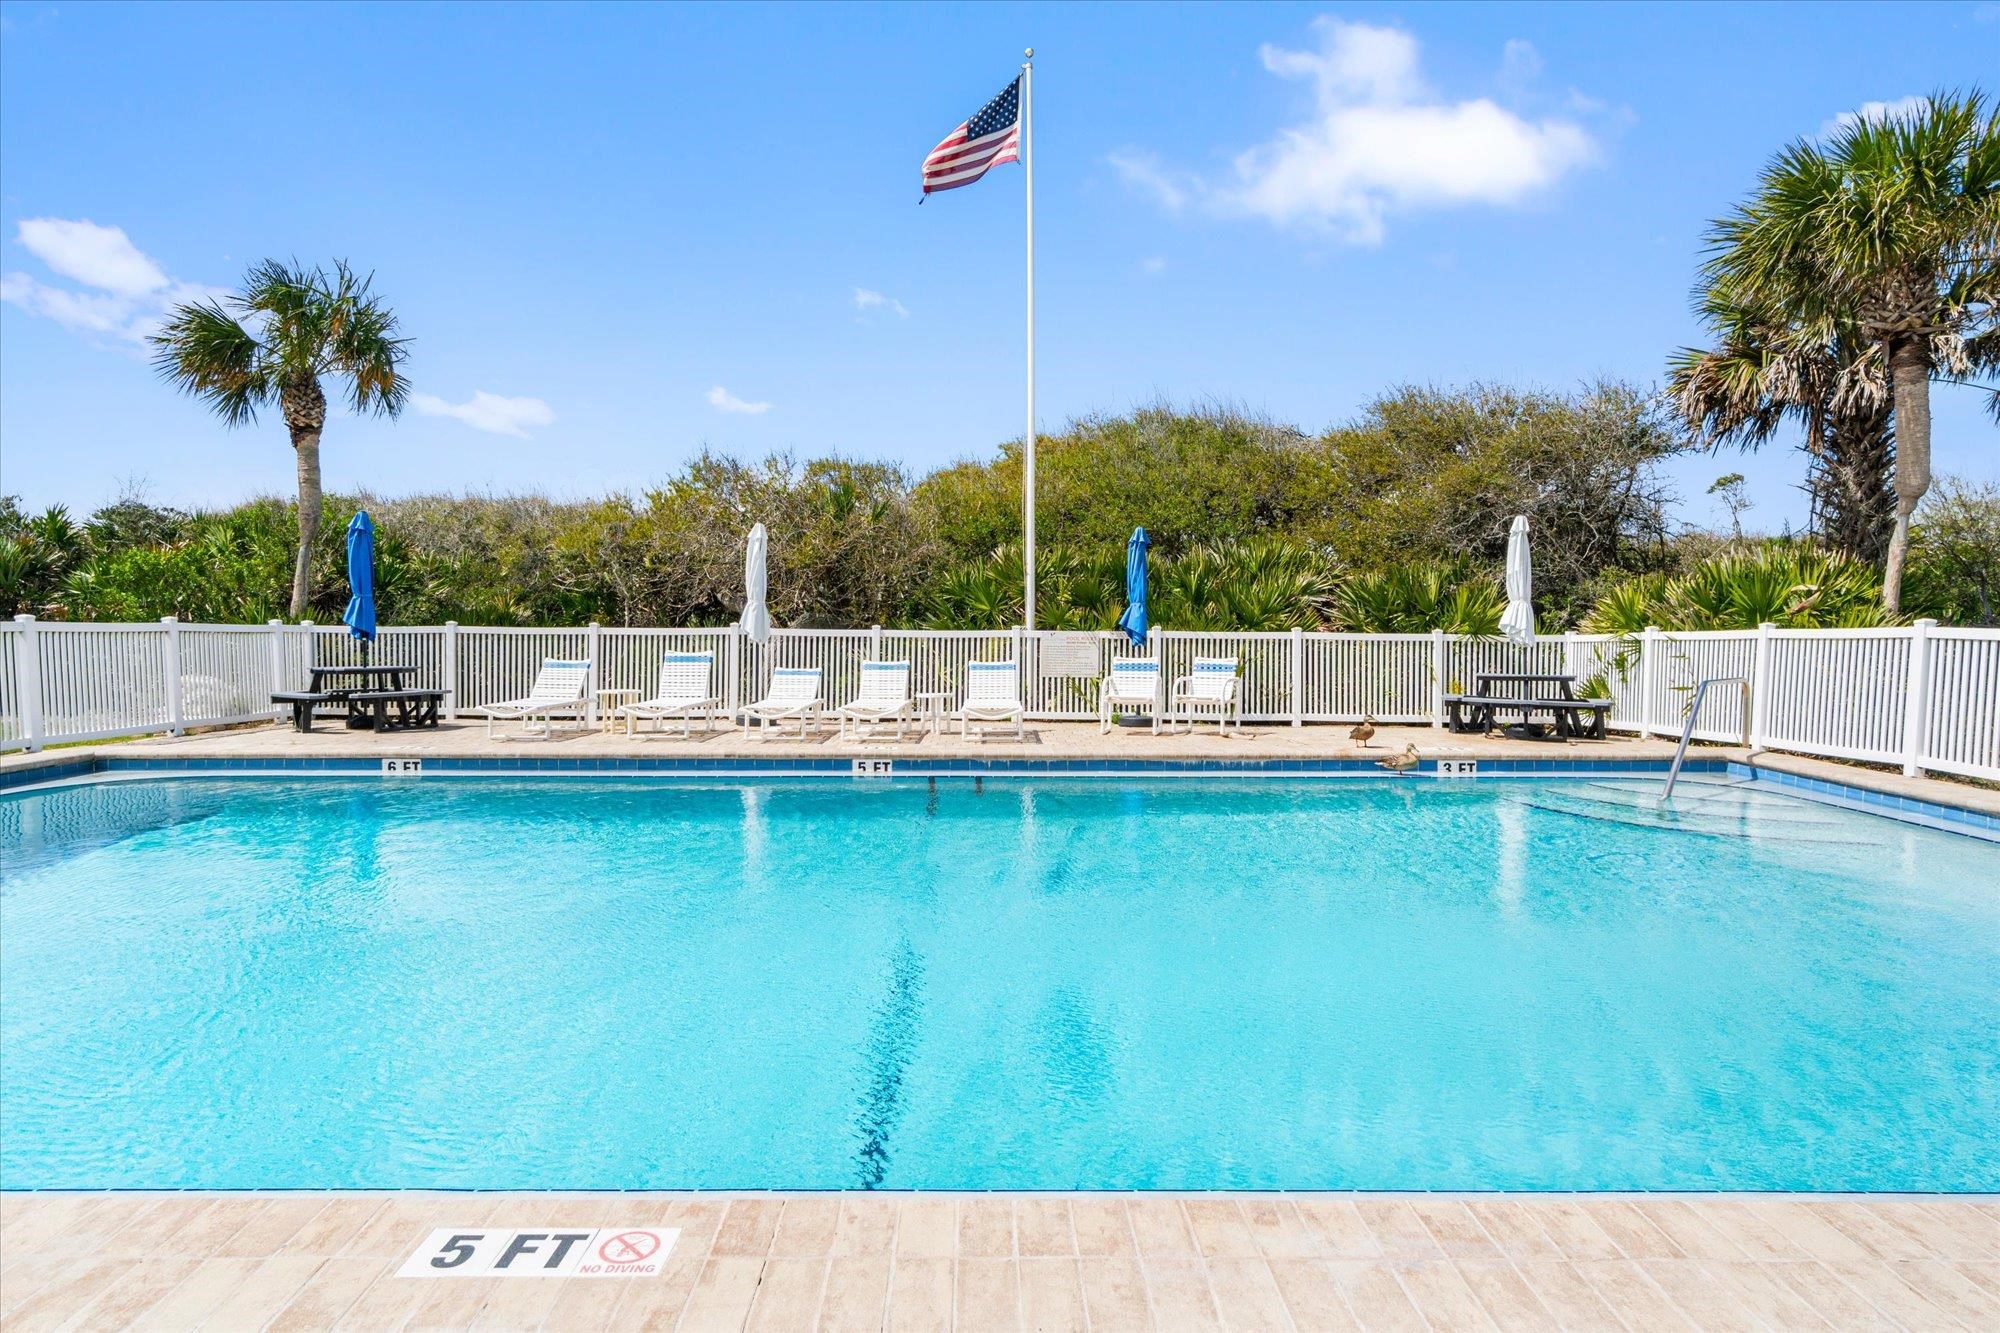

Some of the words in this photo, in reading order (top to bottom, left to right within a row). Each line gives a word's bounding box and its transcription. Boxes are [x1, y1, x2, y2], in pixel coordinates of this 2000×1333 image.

[387, 761, 396, 771] 6
[403, 761, 420, 771] FT
[858, 761, 866, 771] 5
[874, 761, 890, 772] FT
[1443, 763, 1452, 772] 3
[1458, 763, 1475, 773] FT
[430, 1234, 485, 1269] 5
[493, 1233, 590, 1269] FT
[579, 1264, 601, 1273] NO
[604, 1264, 655, 1273] DIVING
